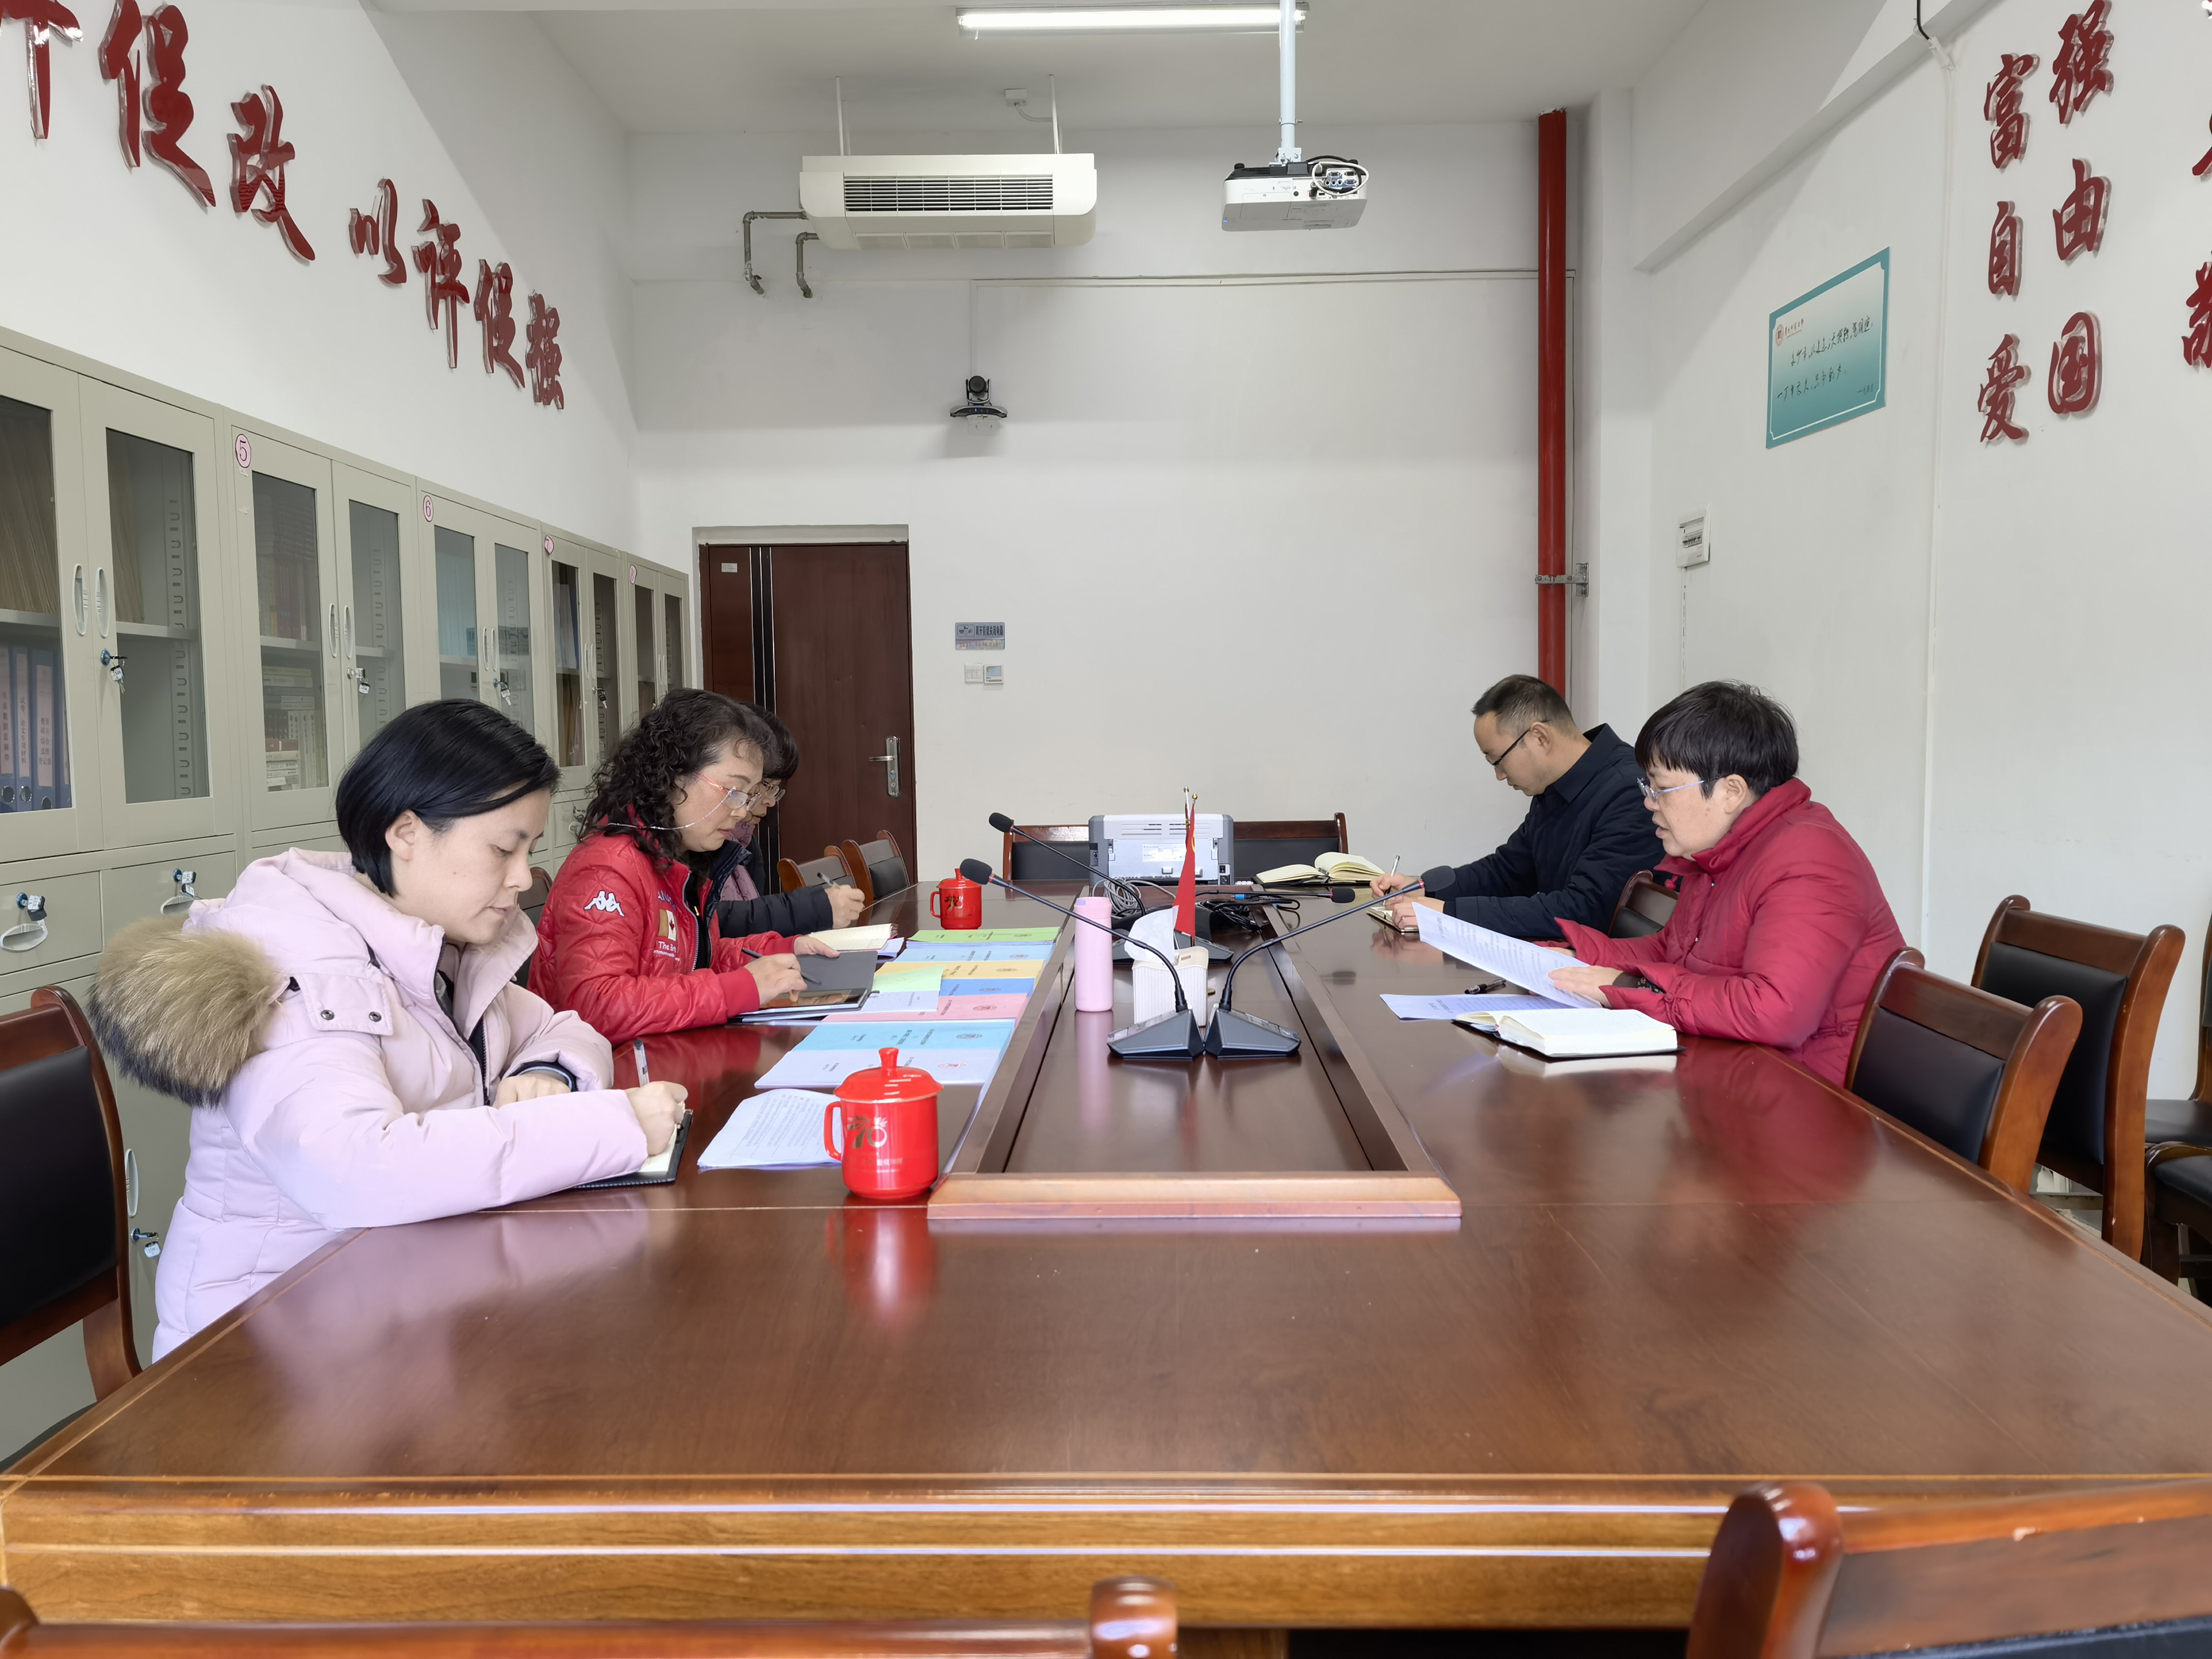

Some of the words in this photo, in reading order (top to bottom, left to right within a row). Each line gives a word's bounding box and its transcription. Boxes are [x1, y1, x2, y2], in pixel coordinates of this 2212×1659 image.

[1984, 0, 2114, 169] 富强
[1988, 158, 2112, 296] 自由
[1978, 311, 2103, 444] 爱国
[658, 941, 670, 950] The
